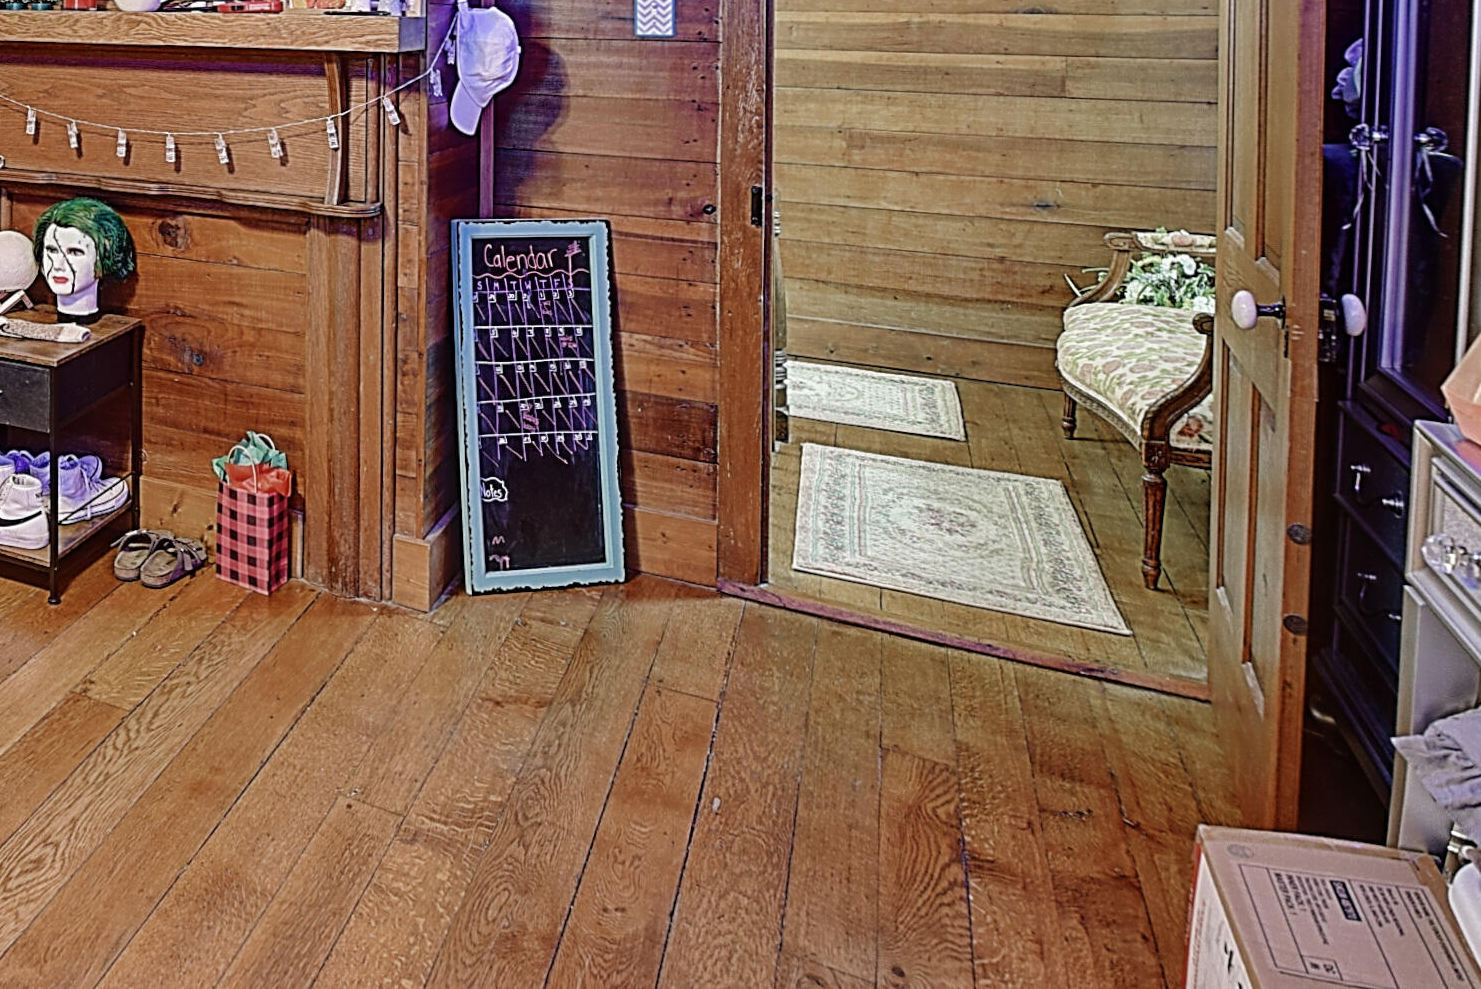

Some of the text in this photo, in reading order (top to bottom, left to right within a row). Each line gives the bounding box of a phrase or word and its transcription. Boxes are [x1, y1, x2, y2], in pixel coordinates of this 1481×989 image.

[484, 244, 558, 272] Calendar
[477, 281, 482, 290] S
[510, 281, 517, 290] T
[539, 280, 547, 288] T
[481, 482, 502, 498] Notes
